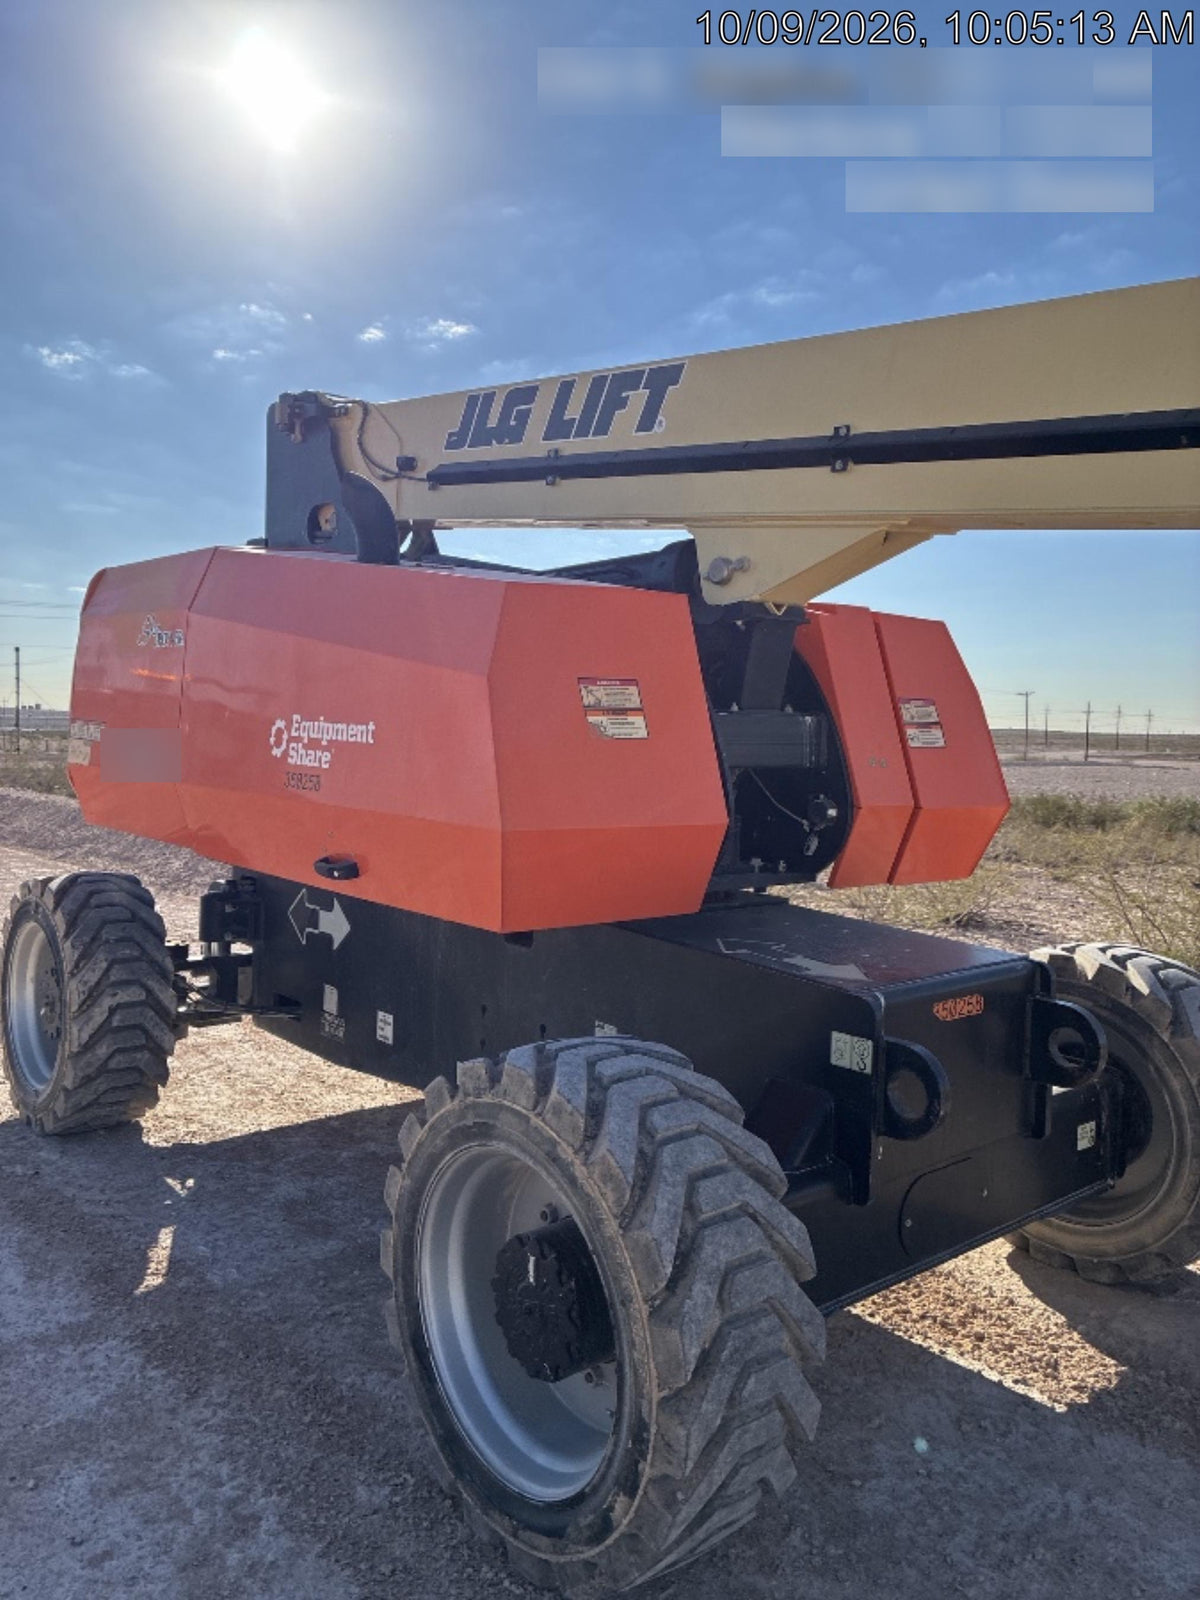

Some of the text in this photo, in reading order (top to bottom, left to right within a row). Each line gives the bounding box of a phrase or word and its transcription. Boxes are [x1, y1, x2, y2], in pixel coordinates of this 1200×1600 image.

[443, 360, 687, 452] JLG LIFT
[290, 713, 376, 746] Equipment
[287, 742, 332, 769] Share
